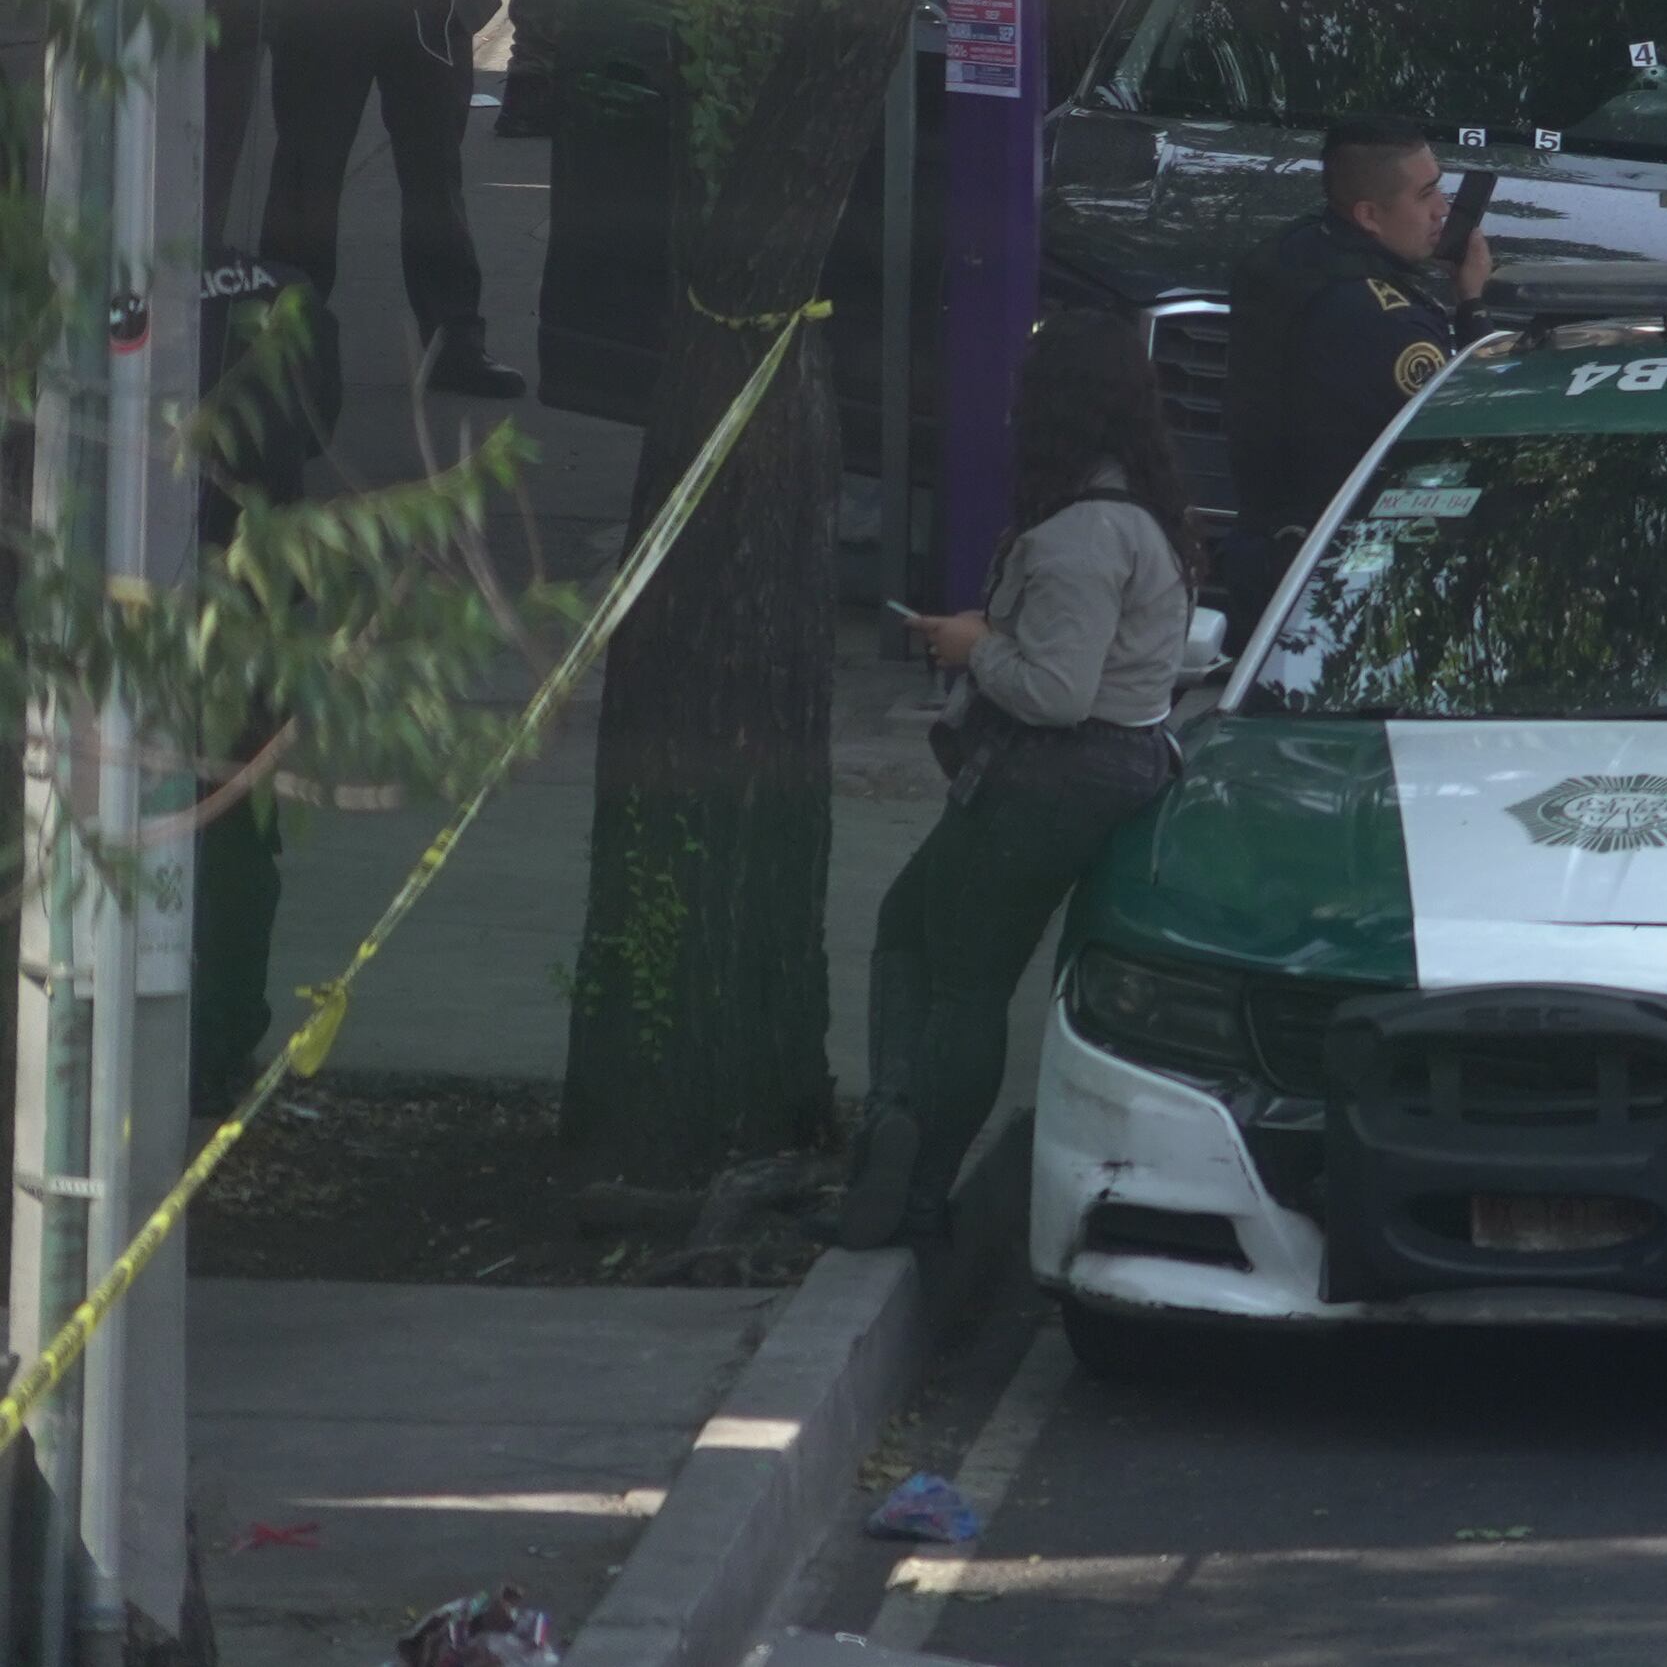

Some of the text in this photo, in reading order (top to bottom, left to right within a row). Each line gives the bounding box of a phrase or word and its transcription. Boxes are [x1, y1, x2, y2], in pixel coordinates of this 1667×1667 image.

[1634, 43, 1654, 64] 4
[1462, 130, 1482, 146] 6
[1538, 131, 1559, 151] 5
